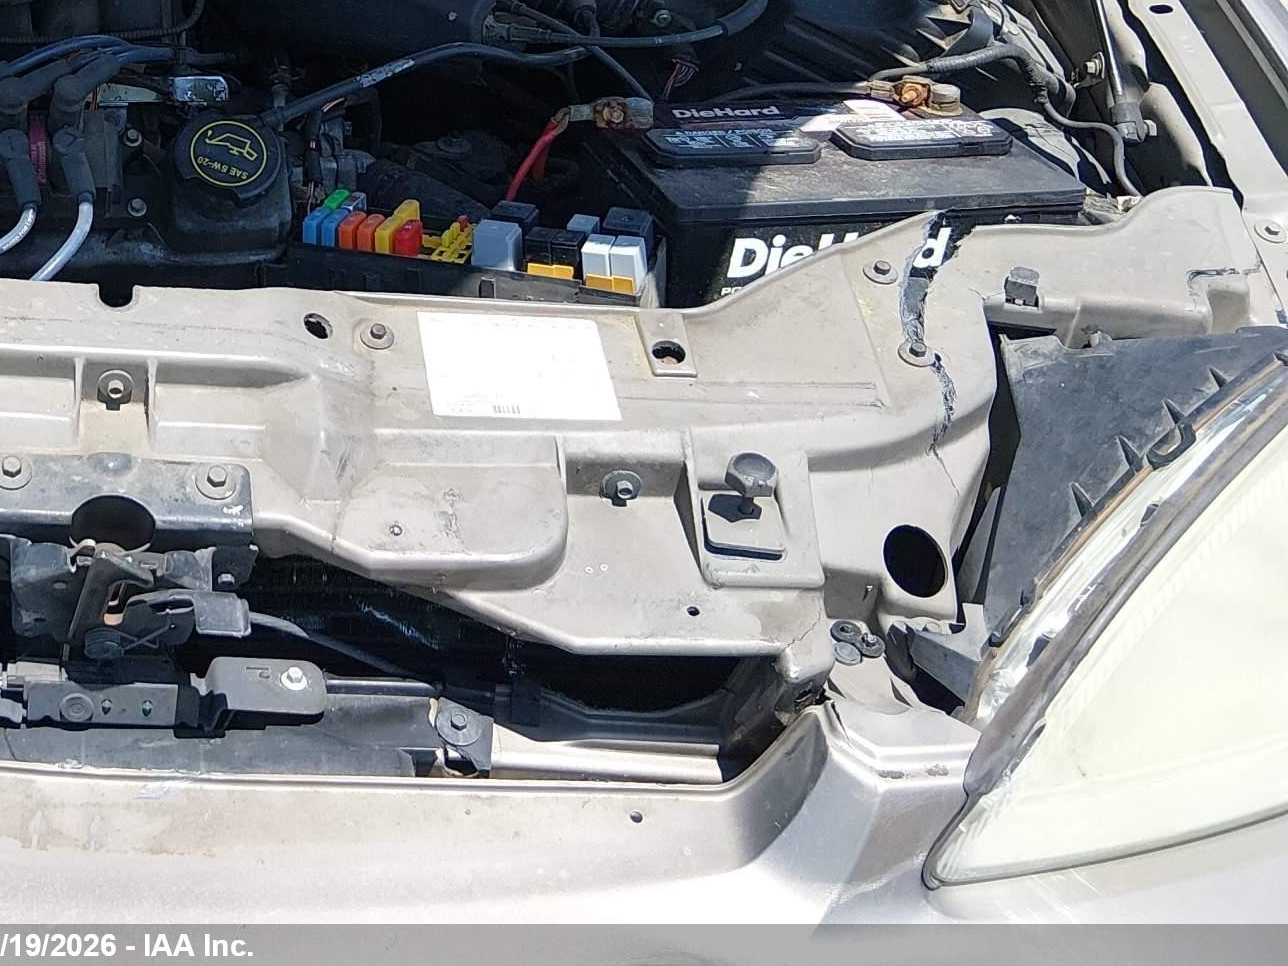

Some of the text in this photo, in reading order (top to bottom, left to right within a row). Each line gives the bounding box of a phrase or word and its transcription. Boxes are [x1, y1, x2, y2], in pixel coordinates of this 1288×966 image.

[672, 106, 780, 118] DieHard
[198, 156, 249, 180] SAE 5W-20
